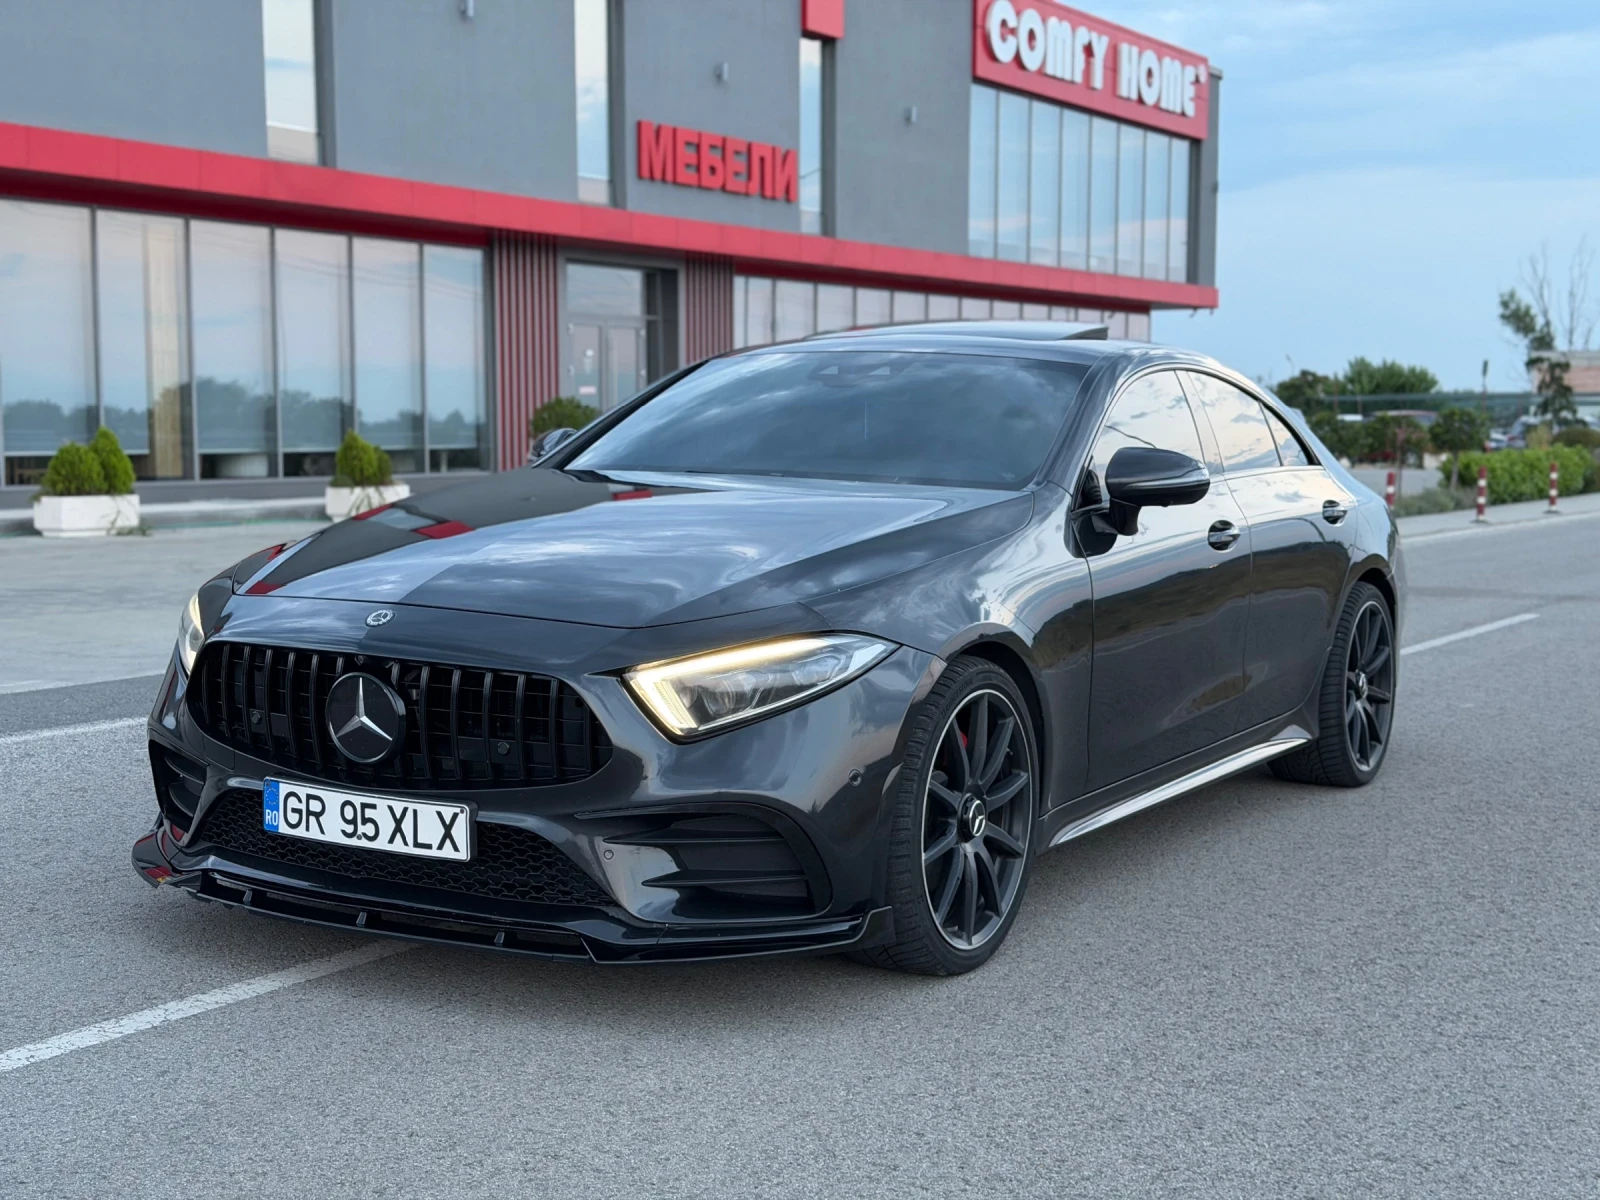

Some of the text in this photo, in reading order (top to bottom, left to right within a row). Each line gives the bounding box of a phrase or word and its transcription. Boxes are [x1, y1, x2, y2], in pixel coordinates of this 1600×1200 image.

[986, 0, 1196, 118] COMFY HOME
[637, 120, 798, 203] МЕБЕЛИ
[265, 809, 279, 826] RO
[283, 791, 461, 853] GR 95 XLX
